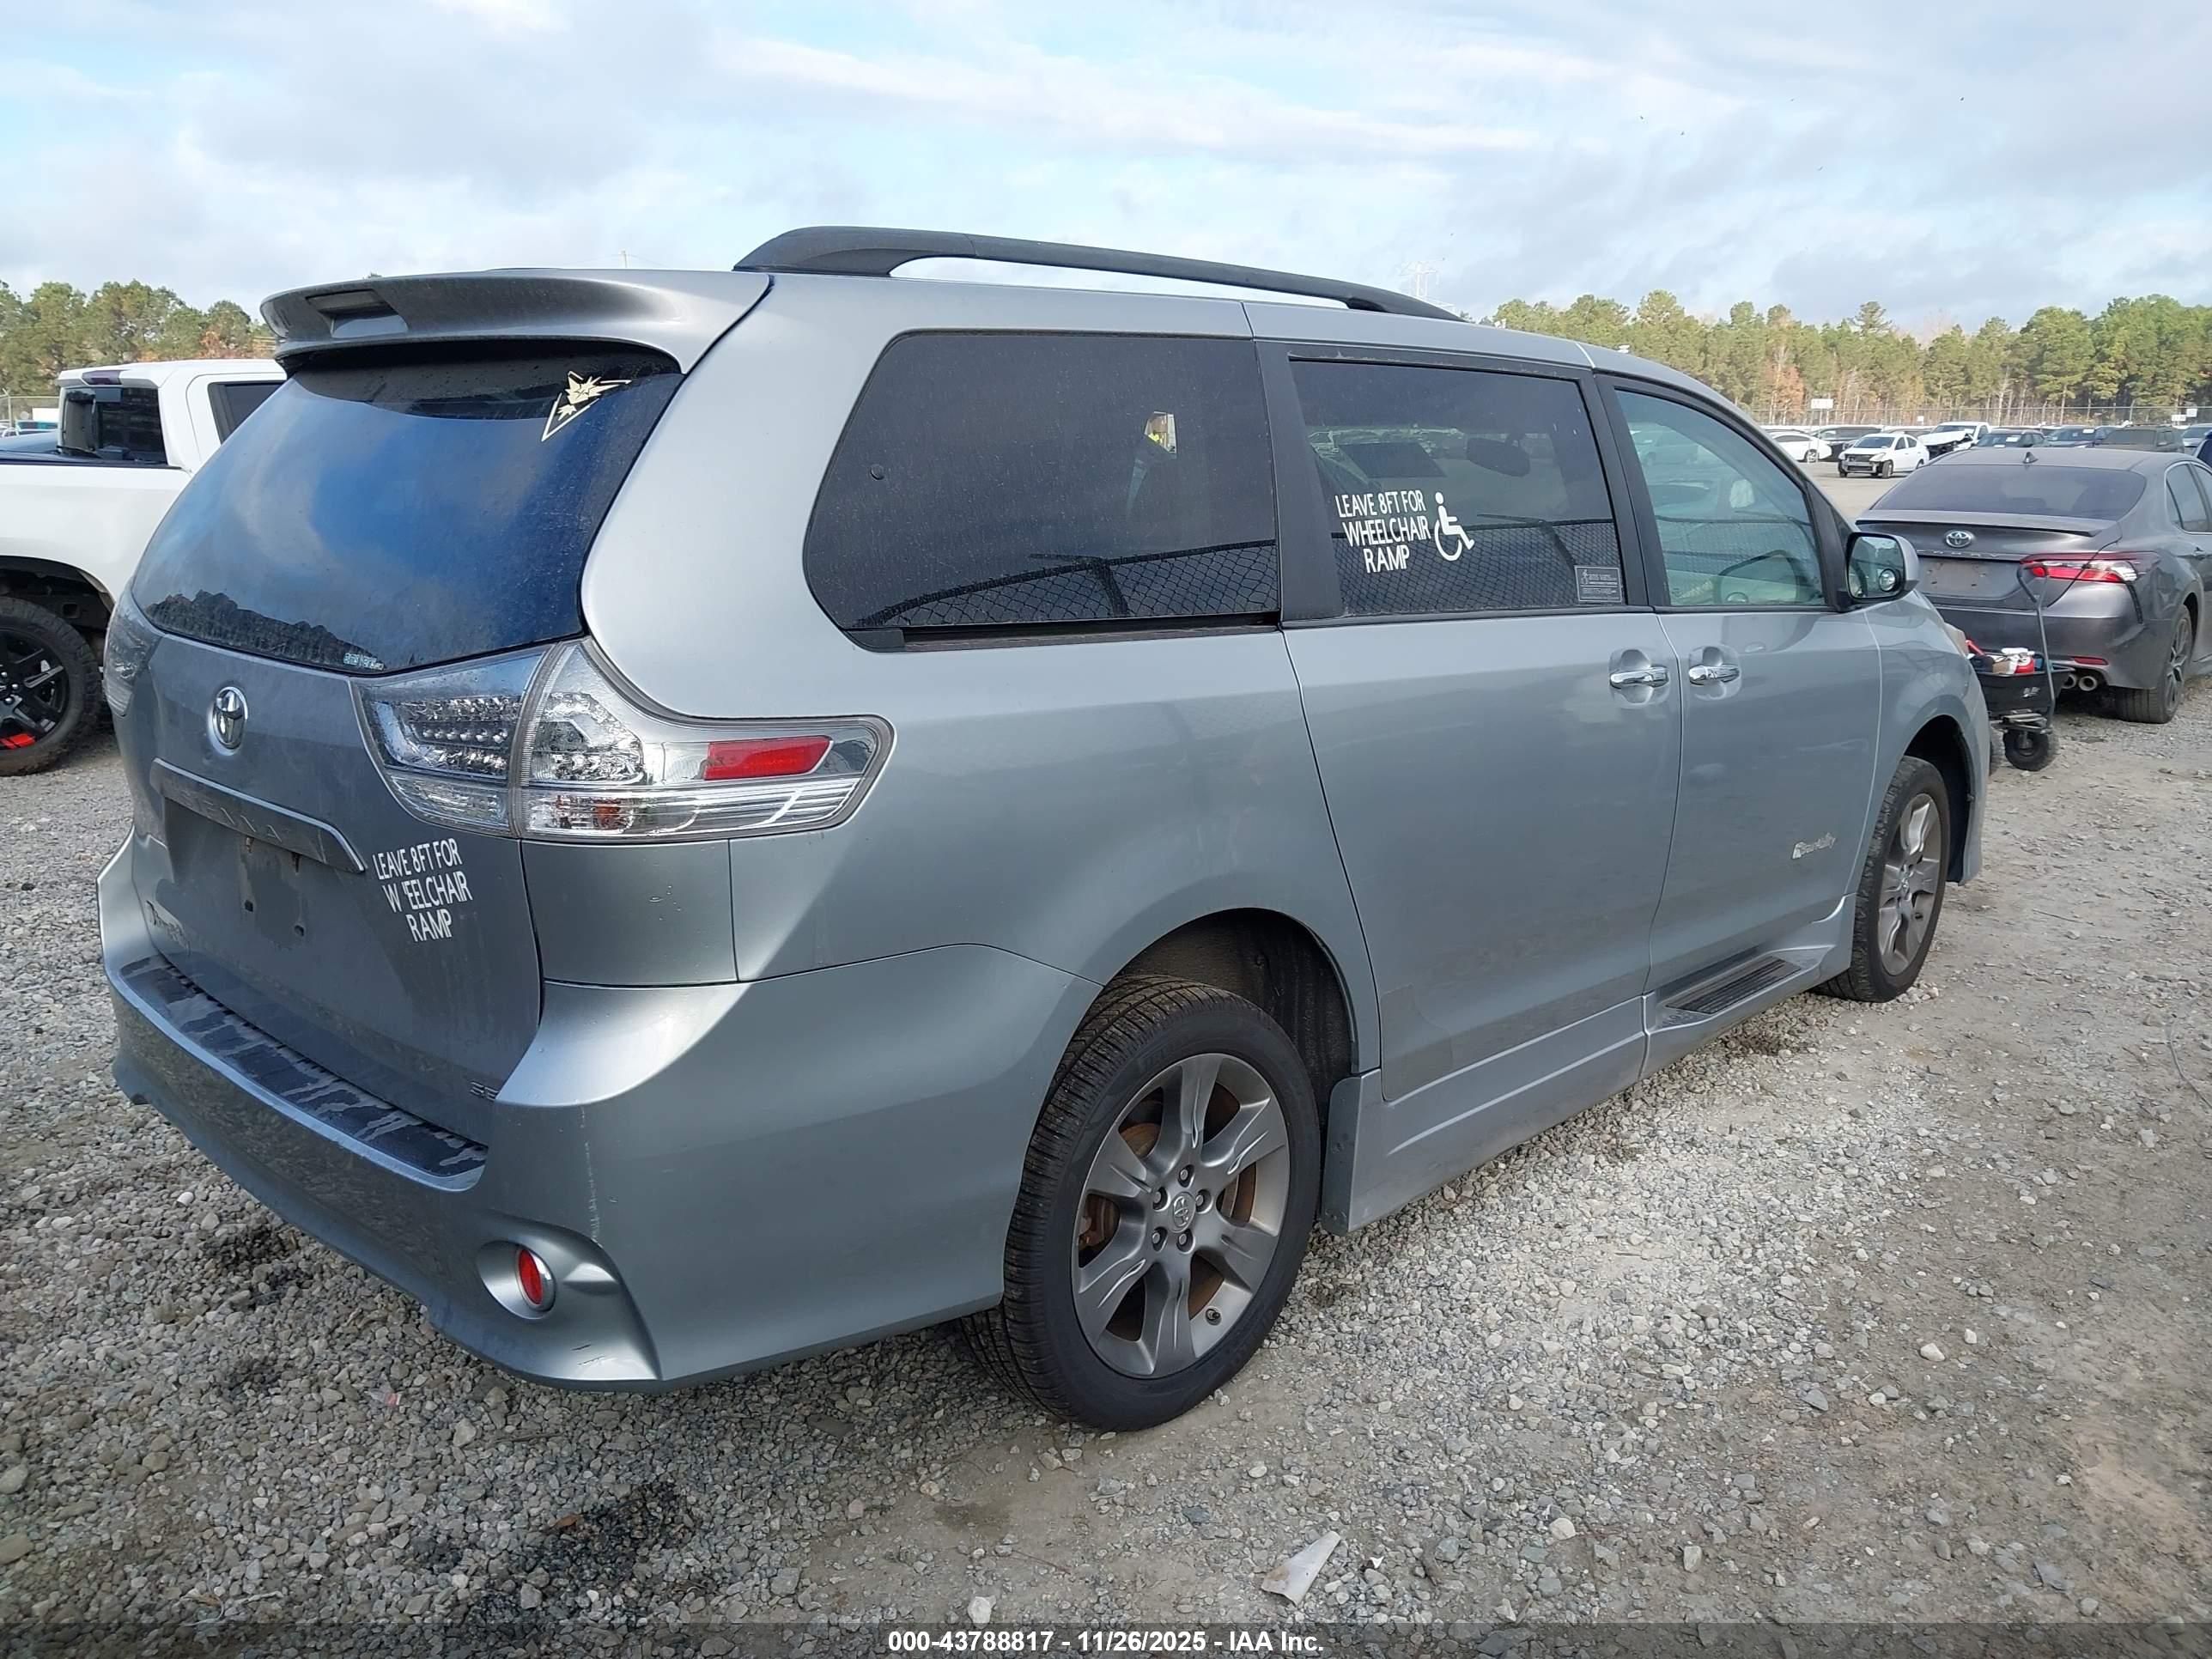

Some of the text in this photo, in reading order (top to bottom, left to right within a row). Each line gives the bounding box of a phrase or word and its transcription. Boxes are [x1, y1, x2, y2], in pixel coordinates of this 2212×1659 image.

[1334, 489, 1426, 518] LEAVE 8FT FOR
[1341, 515, 1431, 547] WHEELCHAIR
[1363, 544, 1410, 573] RAMP
[372, 838, 463, 880] LEAVE 8FT FOR
[405, 908, 453, 942] RAMP
